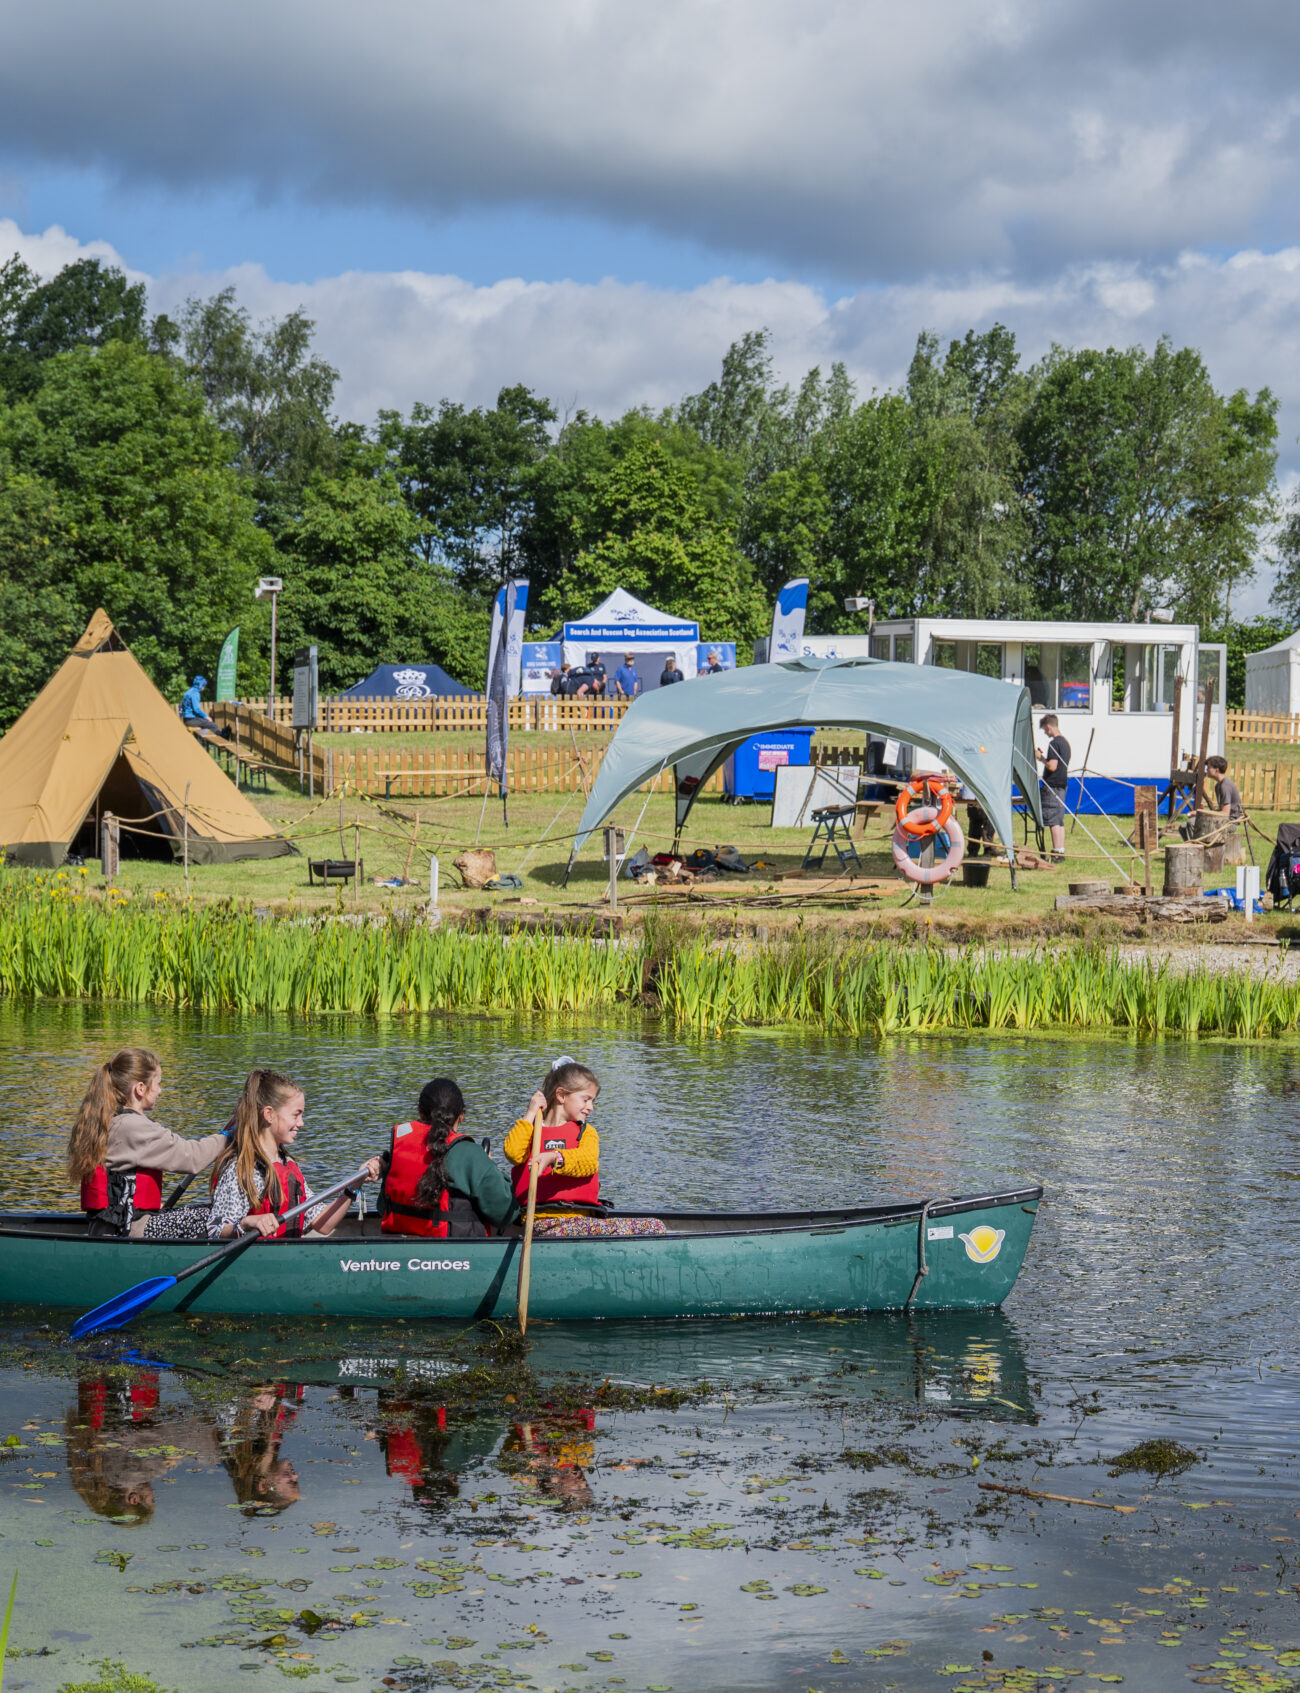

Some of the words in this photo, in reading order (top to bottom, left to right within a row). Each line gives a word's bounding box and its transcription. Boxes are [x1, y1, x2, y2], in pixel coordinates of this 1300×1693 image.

[570, 628, 590, 636] Search
[591, 628, 601, 636] And
[624, 628, 635, 637] Dog
[636, 628, 669, 636] Association
[669, 628, 694, 636] Scotland
[340, 1259, 401, 1272] Venture
[407, 1258, 470, 1271] Canoes
